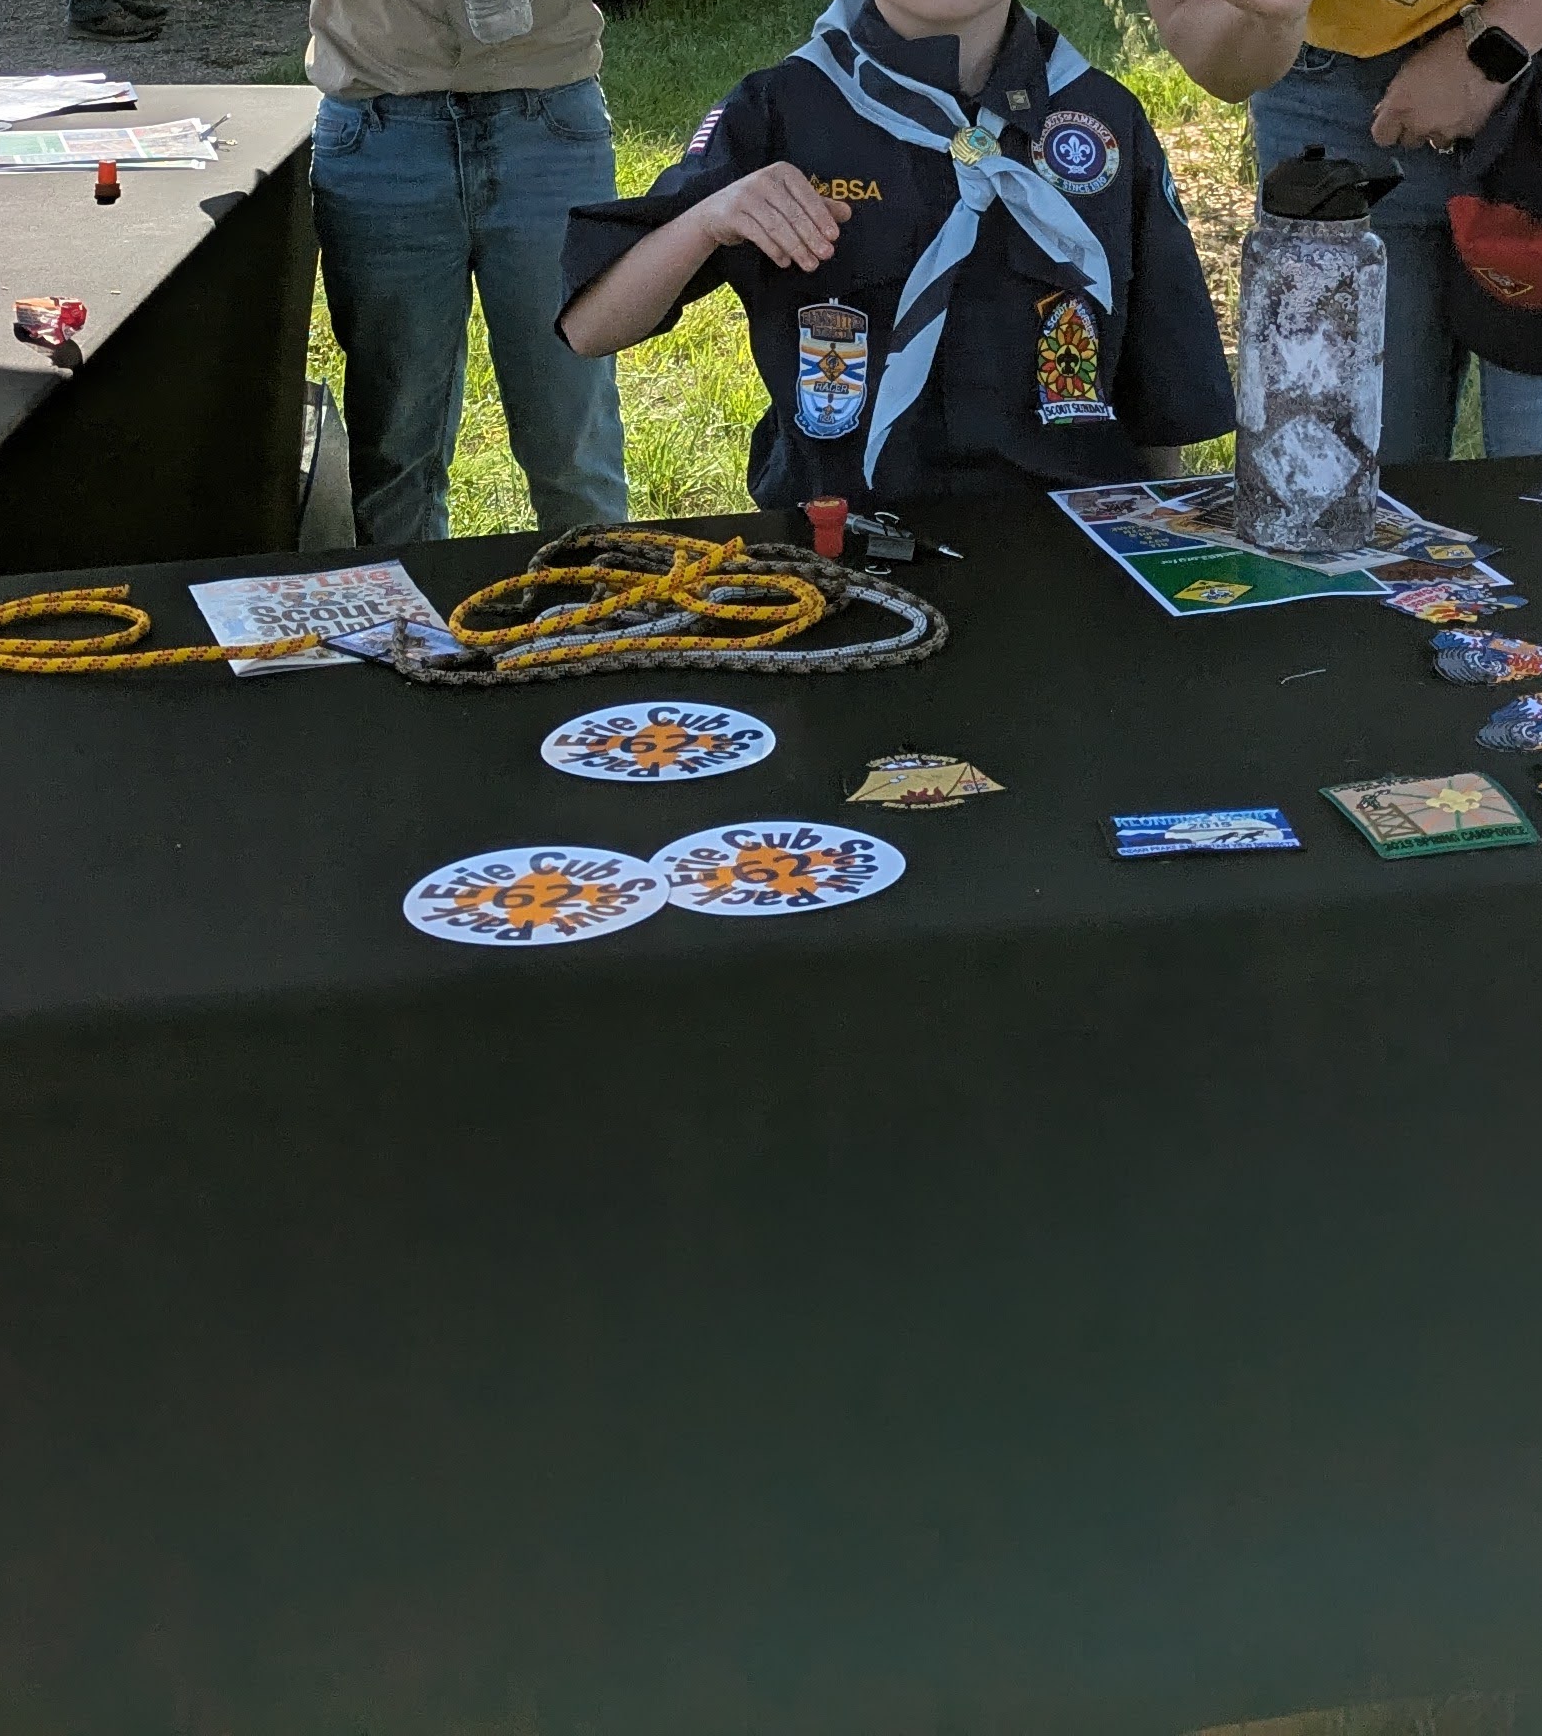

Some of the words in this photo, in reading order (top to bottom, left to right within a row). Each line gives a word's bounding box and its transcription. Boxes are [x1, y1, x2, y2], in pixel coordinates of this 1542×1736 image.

[831, 178, 883, 201] BSA
[1062, 179, 1091, 193] SINCE
[814, 382, 850, 395] RACER
[1045, 405, 1072, 417] SCOUT
[1071, 403, 1107, 415] SUNDAY
[315, 568, 394, 588] Life
[247, 598, 392, 625] Scout
[279, 622, 331, 638] Me
[552, 716, 638, 748] Erie
[646, 706, 731, 733] Cub
[619, 733, 700, 754] 62
[673, 729, 765, 775] Scout
[558, 750, 660, 778] Pack
[1113, 813, 1209, 828] KLONDIKE
[721, 827, 823, 852] Cub
[1417, 832, 1461, 848] SPRING
[1462, 826, 1529, 842] CAMPOREE
[528, 851, 623, 881] Cub
[664, 847, 730, 888] Erie
[731, 853, 828, 884] 62
[814, 838, 880, 895] Scout
[417, 863, 516, 901] Erie
[690, 882, 827, 908] Pack
[492, 884, 584, 909] 62
[549, 876, 657, 937] Scout
[421, 903, 534, 941] Pack
